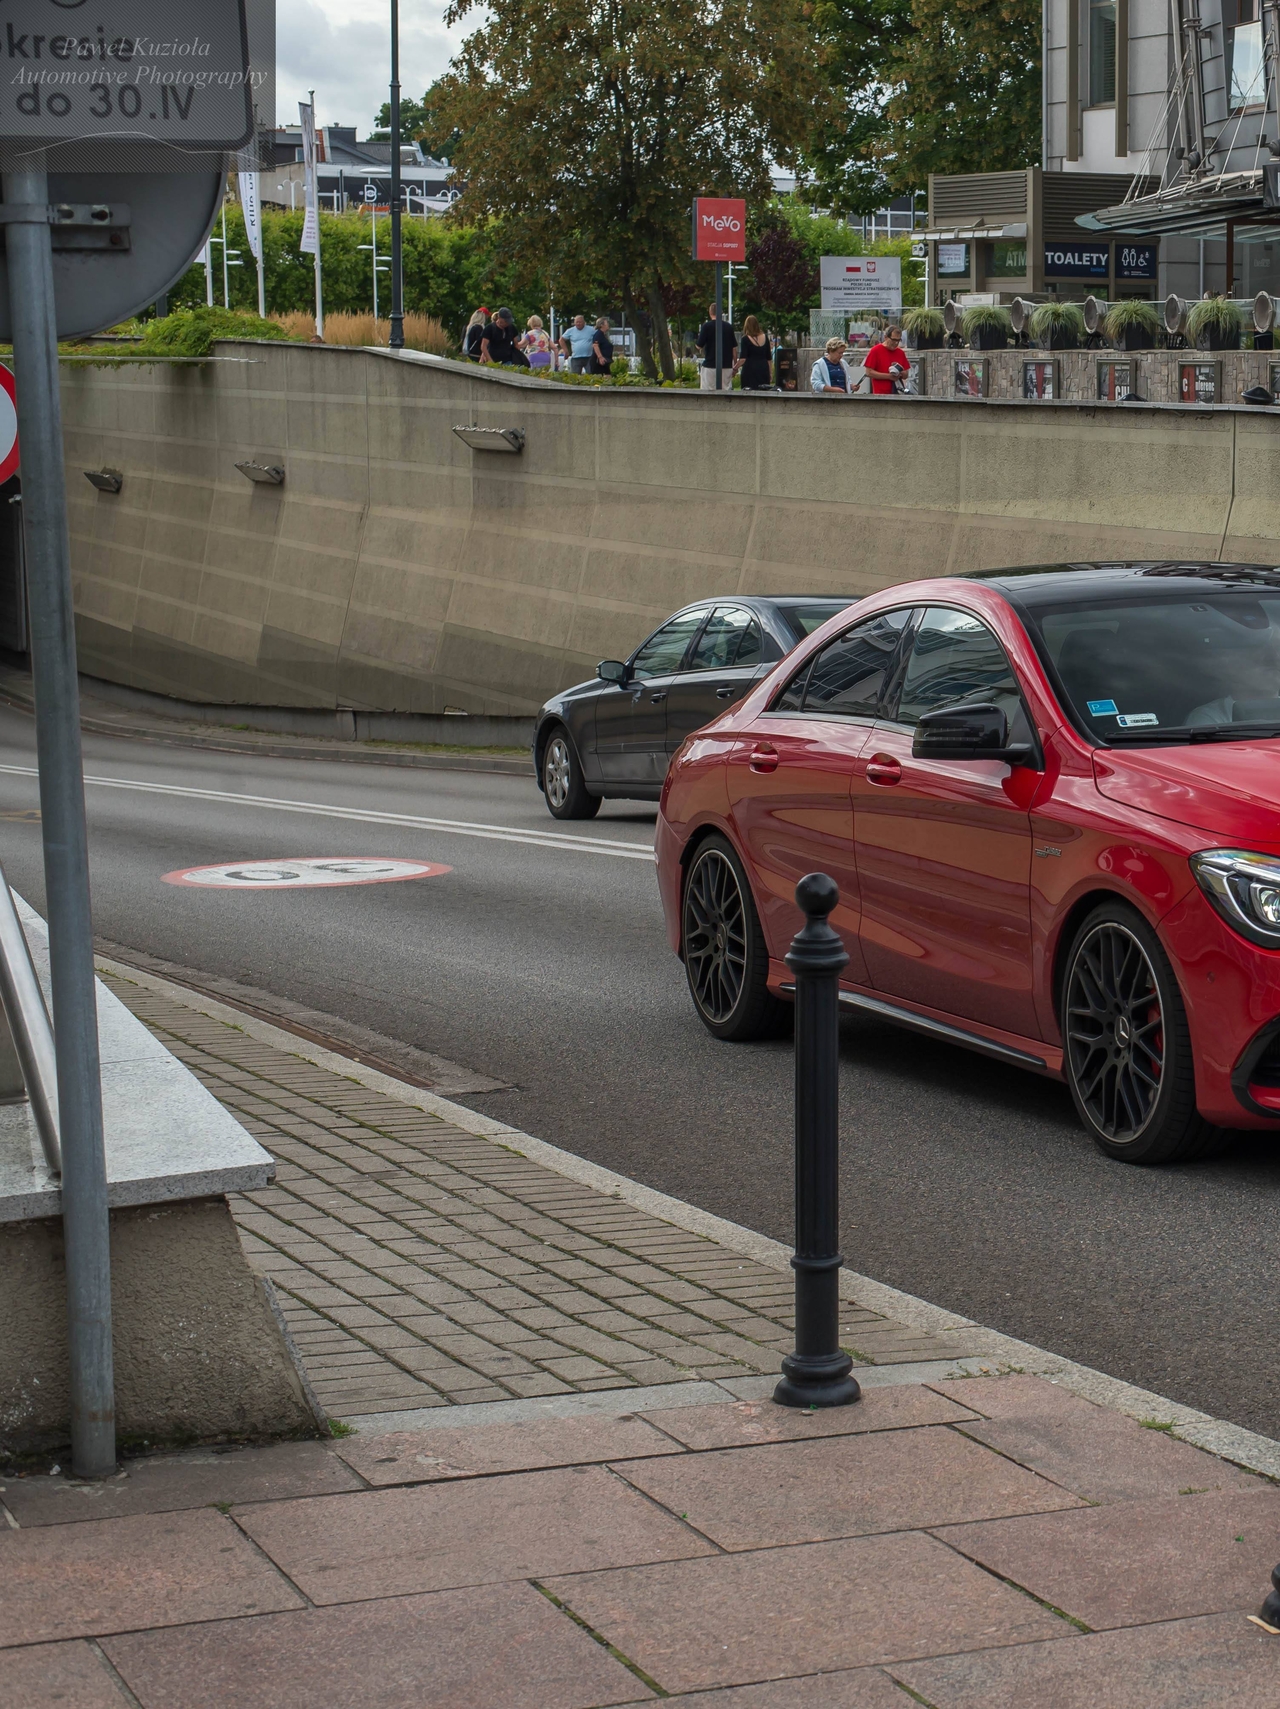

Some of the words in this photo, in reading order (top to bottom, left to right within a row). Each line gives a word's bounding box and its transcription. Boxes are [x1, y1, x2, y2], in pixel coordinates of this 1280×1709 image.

[0, 22, 135, 62] kresie
[16, 83, 72, 117] do
[89, 82, 195, 120] 30.IV
[1045, 252, 1108, 266] TOALETY
